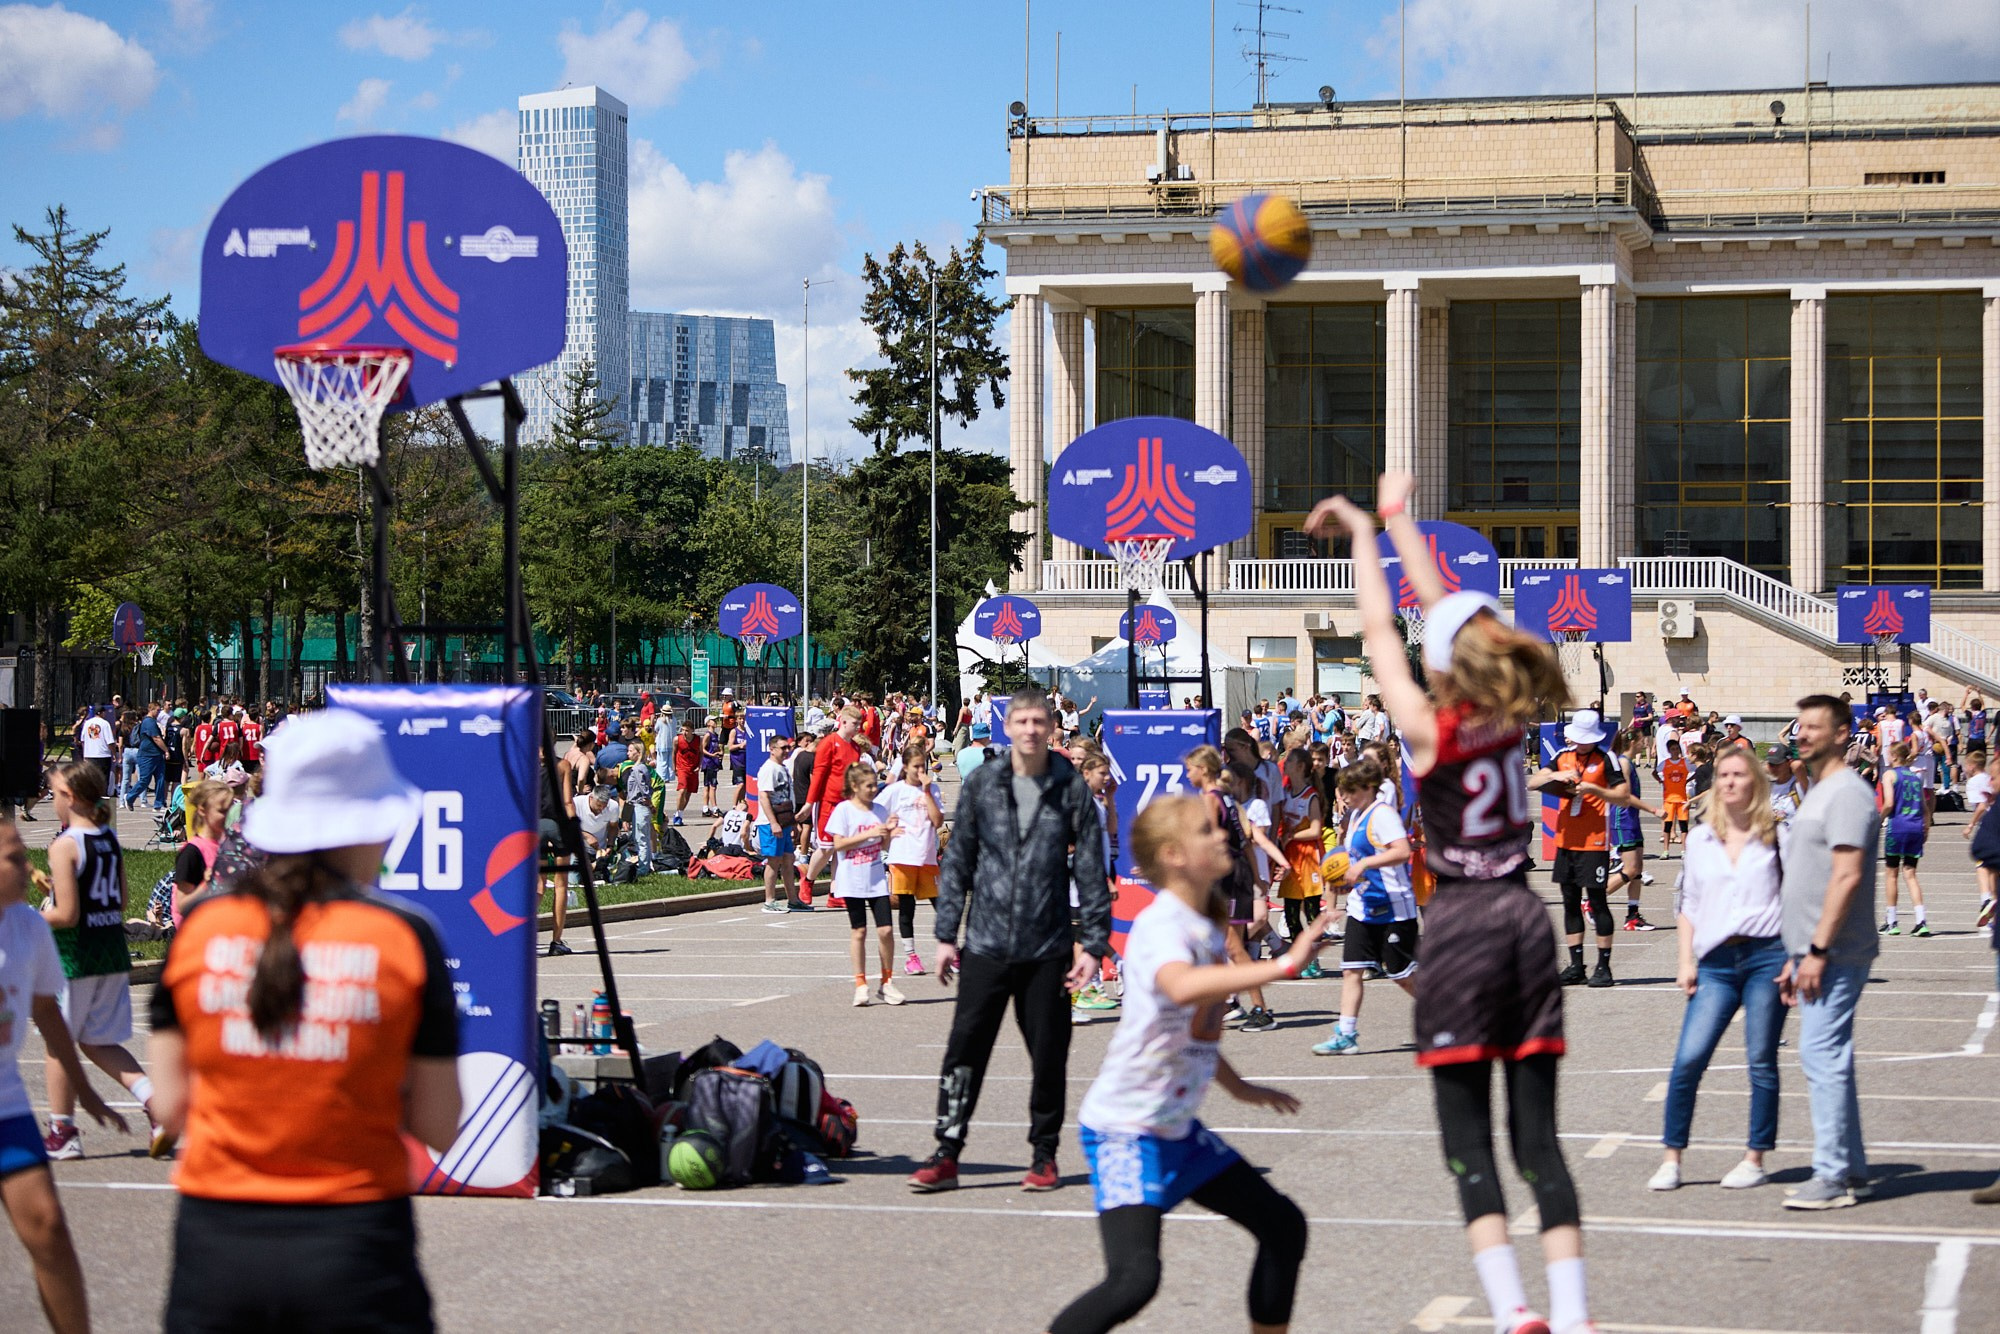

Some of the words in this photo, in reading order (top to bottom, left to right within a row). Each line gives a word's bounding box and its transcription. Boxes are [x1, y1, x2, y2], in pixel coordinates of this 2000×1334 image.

[223, 726, 235, 740] 11
[244, 729, 257, 741] 21
[1461, 747, 1528, 838] 20
[379, 790, 464, 891] 26
[724, 819, 742, 833] 55
[89, 853, 122, 907] 44
